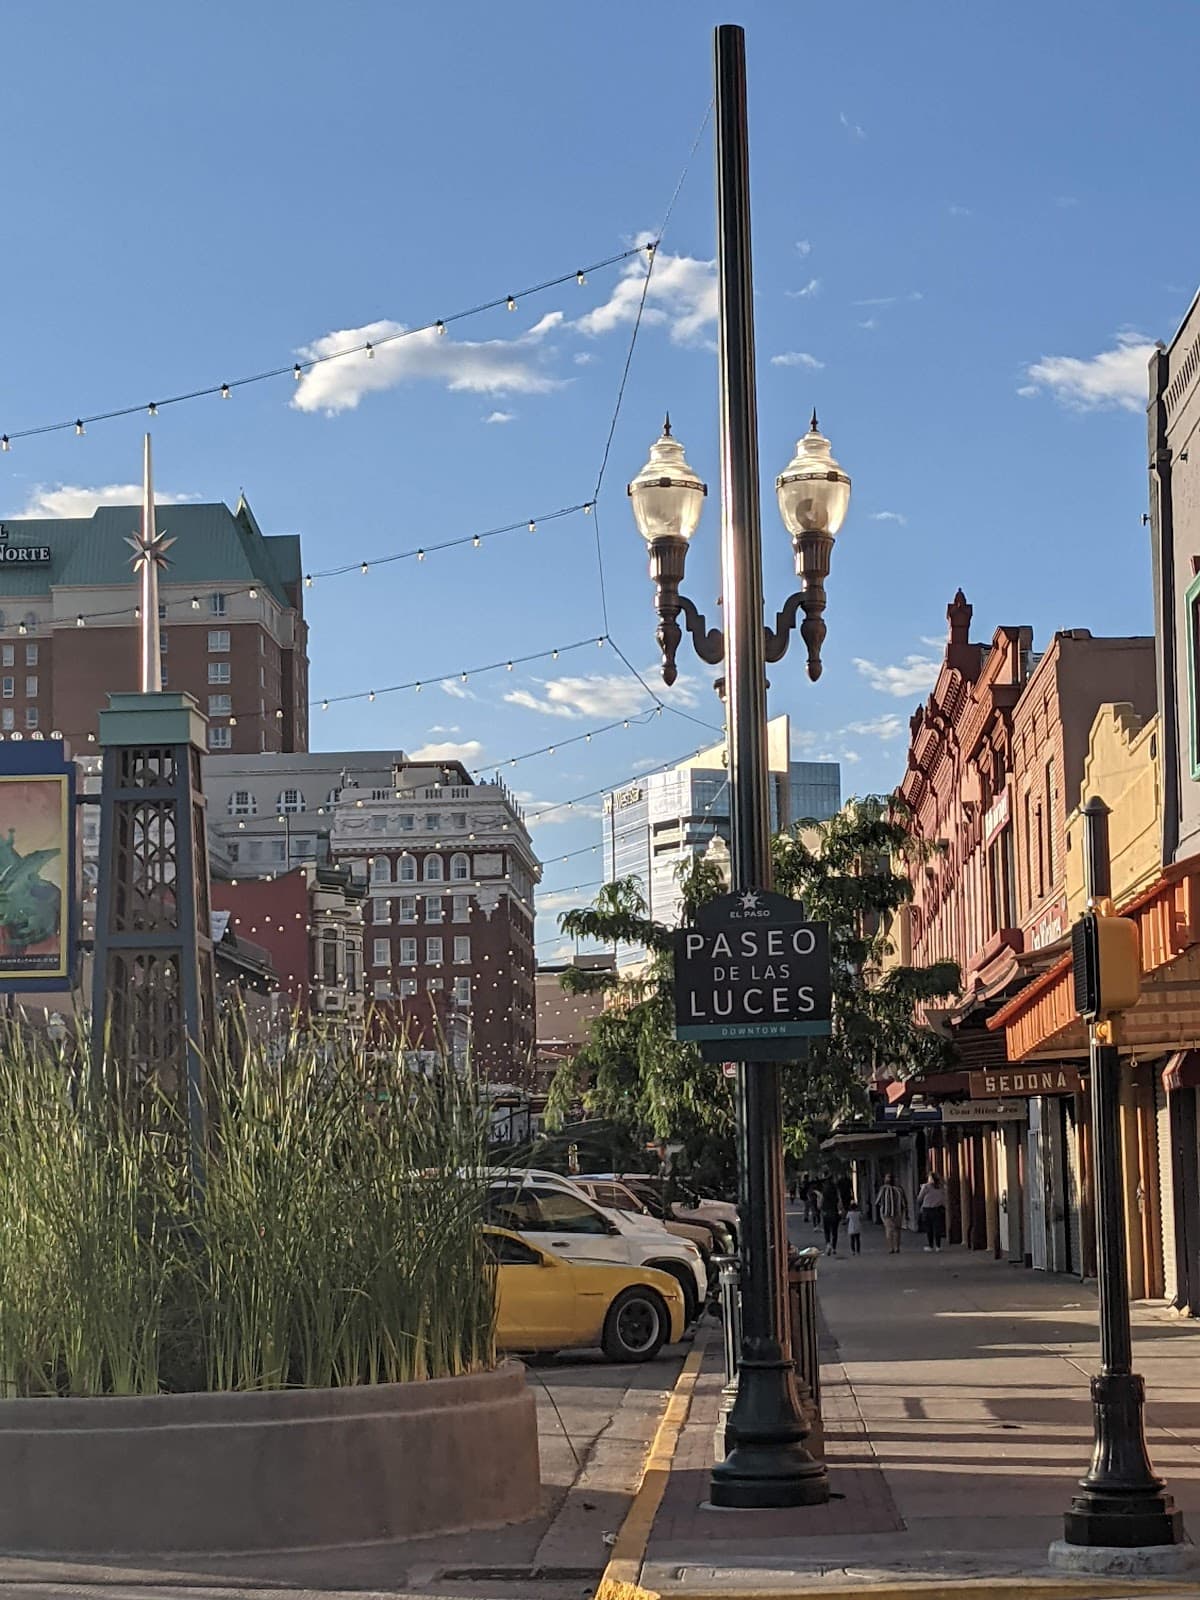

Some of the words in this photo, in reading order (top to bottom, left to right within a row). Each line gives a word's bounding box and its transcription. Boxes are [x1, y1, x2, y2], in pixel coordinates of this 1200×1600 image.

[730, 911, 742, 919] EL
[744, 909, 770, 918] PASO
[686, 928, 816, 960] PASEO
[713, 966, 740, 982] DE
[751, 964, 790, 980] LAS
[691, 986, 815, 1017] LUCES
[721, 1025, 787, 1036] DOWNTOWN
[985, 1071, 1067, 1092] SEDONA
